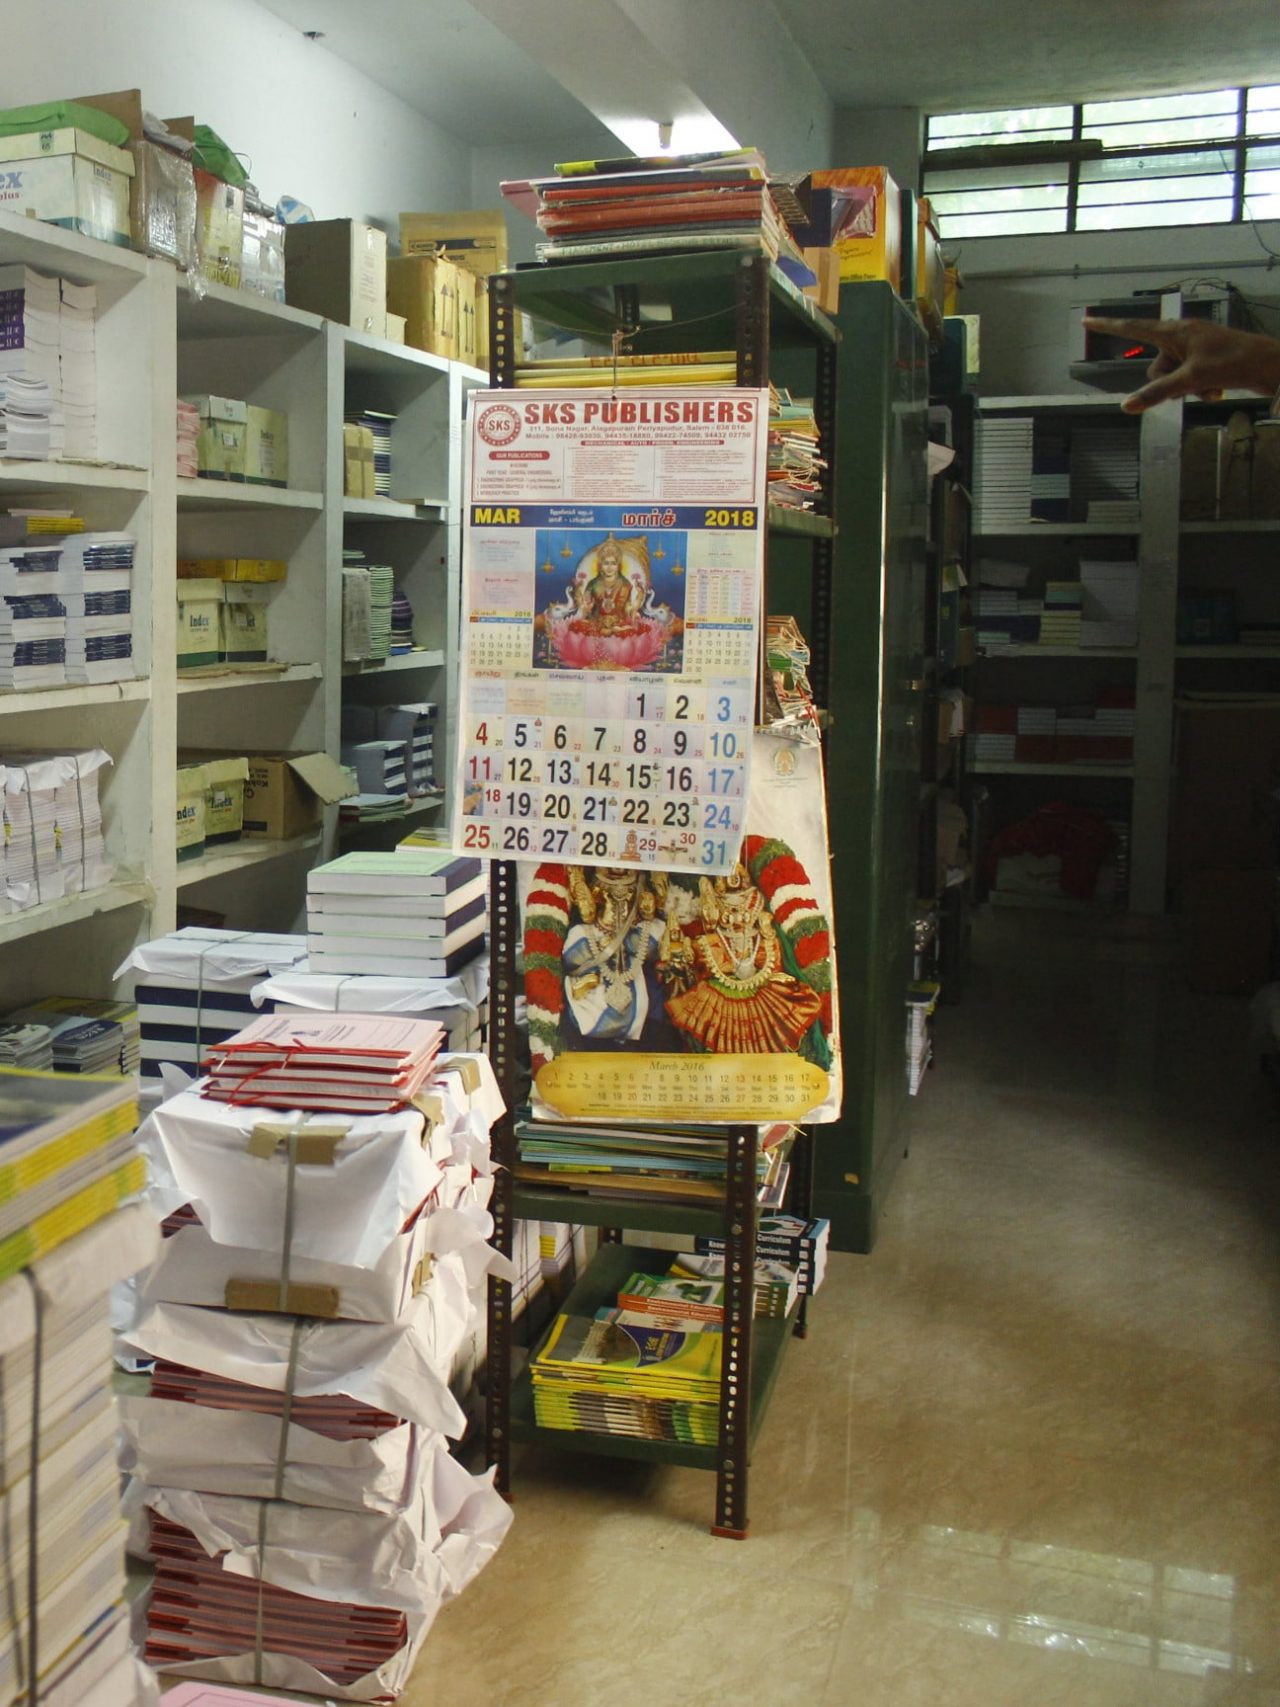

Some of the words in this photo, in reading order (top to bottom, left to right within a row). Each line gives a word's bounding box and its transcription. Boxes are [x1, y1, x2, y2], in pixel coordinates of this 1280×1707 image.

[525, 403, 575, 424] SKS
[584, 402, 753, 424] PUBLISHERS
[488, 419, 511, 432] SKS
[475, 508, 520, 524] MAR
[623, 509, 675, 527] மார்ச்
[705, 511, 754, 526] 2018
[189, 615, 210, 628] Index
[637, 693, 646, 717] 1
[676, 695, 688, 720] 2
[718, 696, 730, 722] 3
[476, 723, 488, 745] 4
[515, 724, 526, 747] 5
[554, 725, 566, 749] 6
[594, 727, 606, 750] 7
[634, 729, 646, 753] 8
[675, 731, 687, 754] 9
[710, 732, 736, 758] 10
[470, 757, 491, 779] 11
[509, 758, 532, 781] 12
[548, 760, 571, 784] 13
[587, 763, 611, 786] 14
[627, 764, 651, 789] 15
[667, 767, 692, 792] 16
[709, 769, 734, 793] 17
[176, 806, 196, 821] ndex
[486, 790, 500, 801] 18
[507, 793, 531, 816] 19
[544, 795, 570, 819] 20
[584, 797, 607, 821] 21
[623, 800, 649, 824] 22
[663, 802, 689, 827] 23
[704, 804, 730, 829] 24
[464, 826, 490, 848] 25
[504, 827, 529, 850] 26
[542, 830, 569, 853] 27
[581, 832, 607, 856] 28
[639, 839, 656, 850] 29
[680, 833, 696, 844] 30
[702, 840, 726, 866] 31
[649, 1061, 677, 1070] March
[681, 1062, 705, 1071] 2016
[688, 1074, 697, 1082] 10
[768, 1074, 778, 1082] 15
[785, 1074, 794, 1082] 16
[802, 1074, 809, 1082] 17
[643, 1093, 651, 1101] 21
[708, 1240, 726, 1249] Know
[757, 1234, 792, 1245] Curriculum
[755, 1246, 791, 1257] Curriculum
